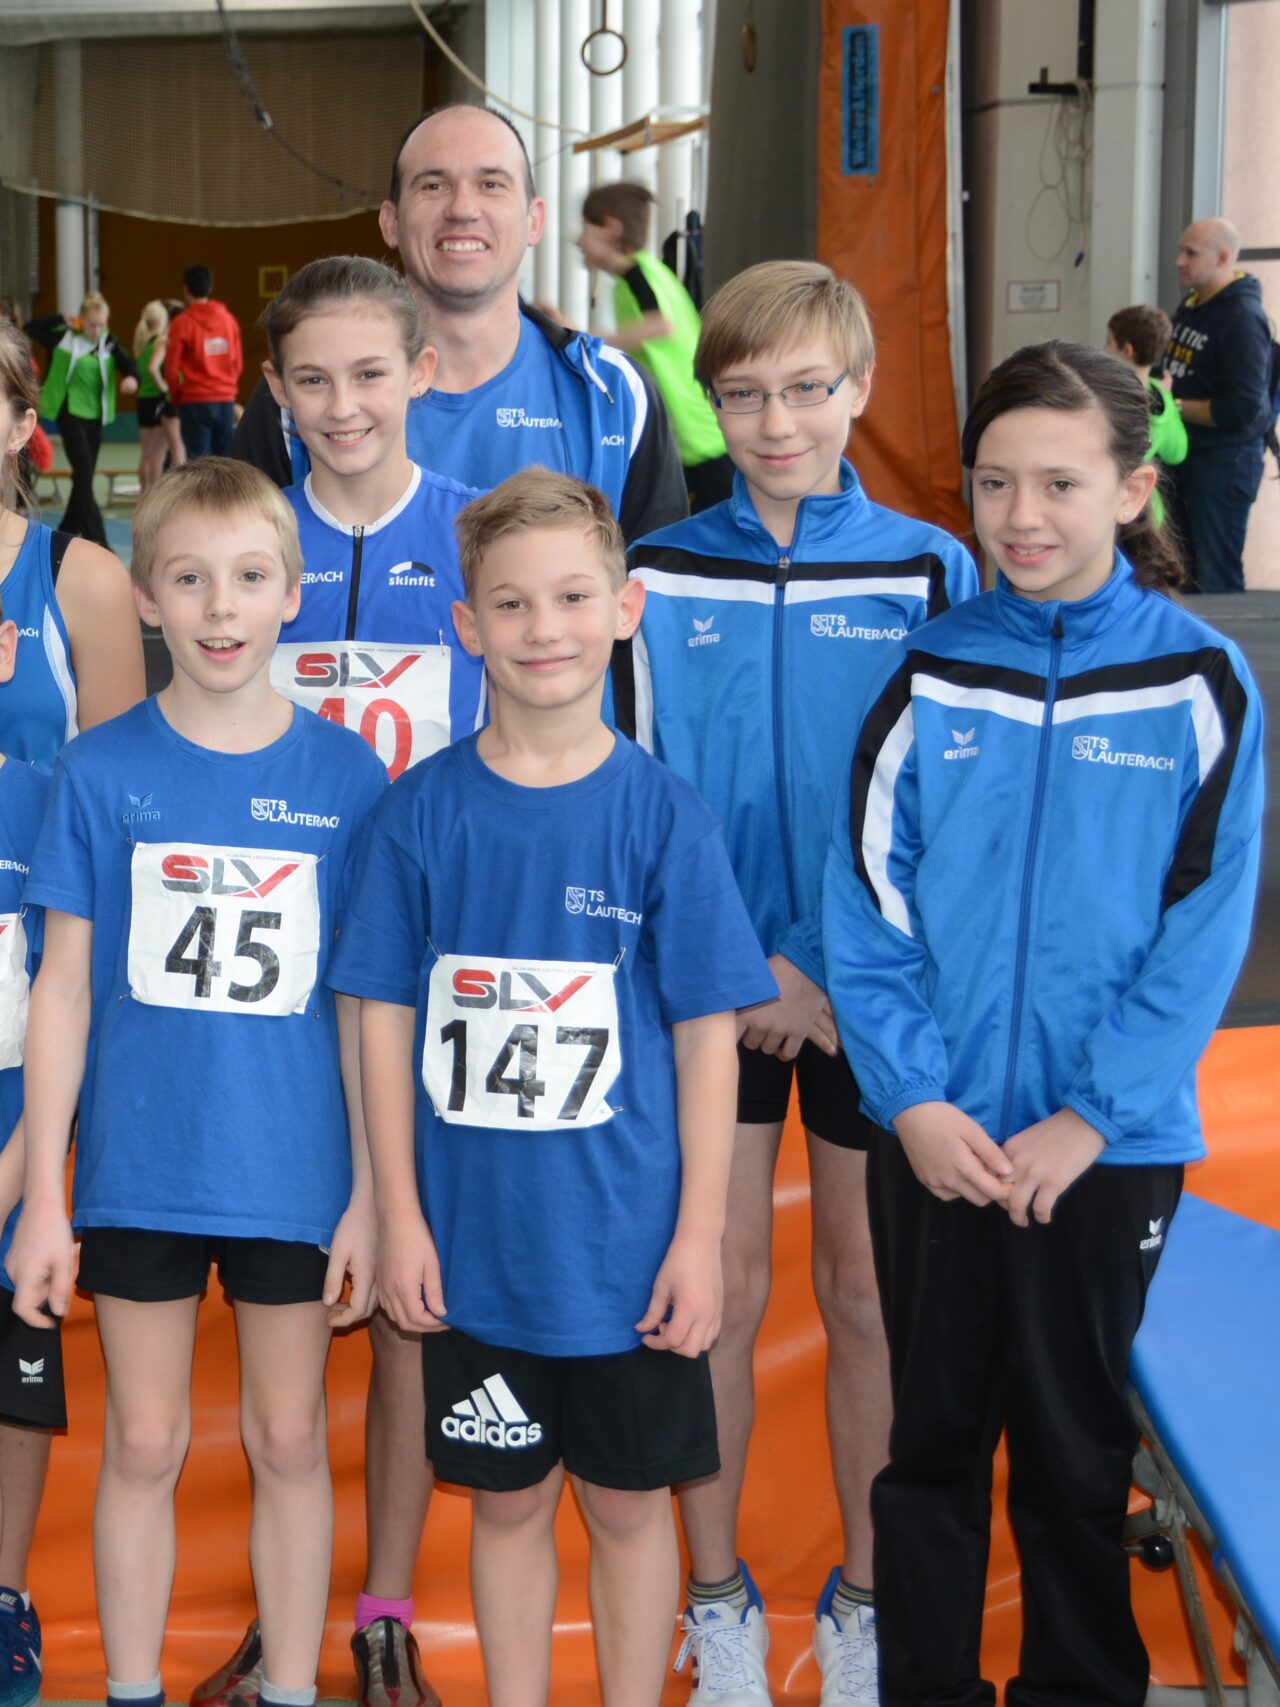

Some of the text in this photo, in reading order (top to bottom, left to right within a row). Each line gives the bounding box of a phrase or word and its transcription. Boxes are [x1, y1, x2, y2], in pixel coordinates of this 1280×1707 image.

[511, 408, 525, 417] TS
[511, 416, 563, 428] LAUTERA
[300, 571, 343, 584] ERACH
[388, 575, 436, 587] skinfit
[829, 615, 846, 626] TS
[688, 632, 720, 648] erima
[294, 652, 422, 688] SLV
[1091, 736, 1109, 750] TS
[944, 746, 979, 760] erima
[1088, 749, 1174, 771] LAUTERACH
[271, 800, 287, 811] TS
[122, 810, 161, 823] erima
[161, 854, 302, 899] SLV
[588, 890, 605, 902] TS
[586, 904, 642, 925] LAUTECH
[164, 905, 283, 1003] 45
[452, 968, 593, 1014] SLV
[440, 1019, 609, 1121] 147
[21, 1375, 44, 1383] erima
[441, 1415, 542, 1448] adidas
